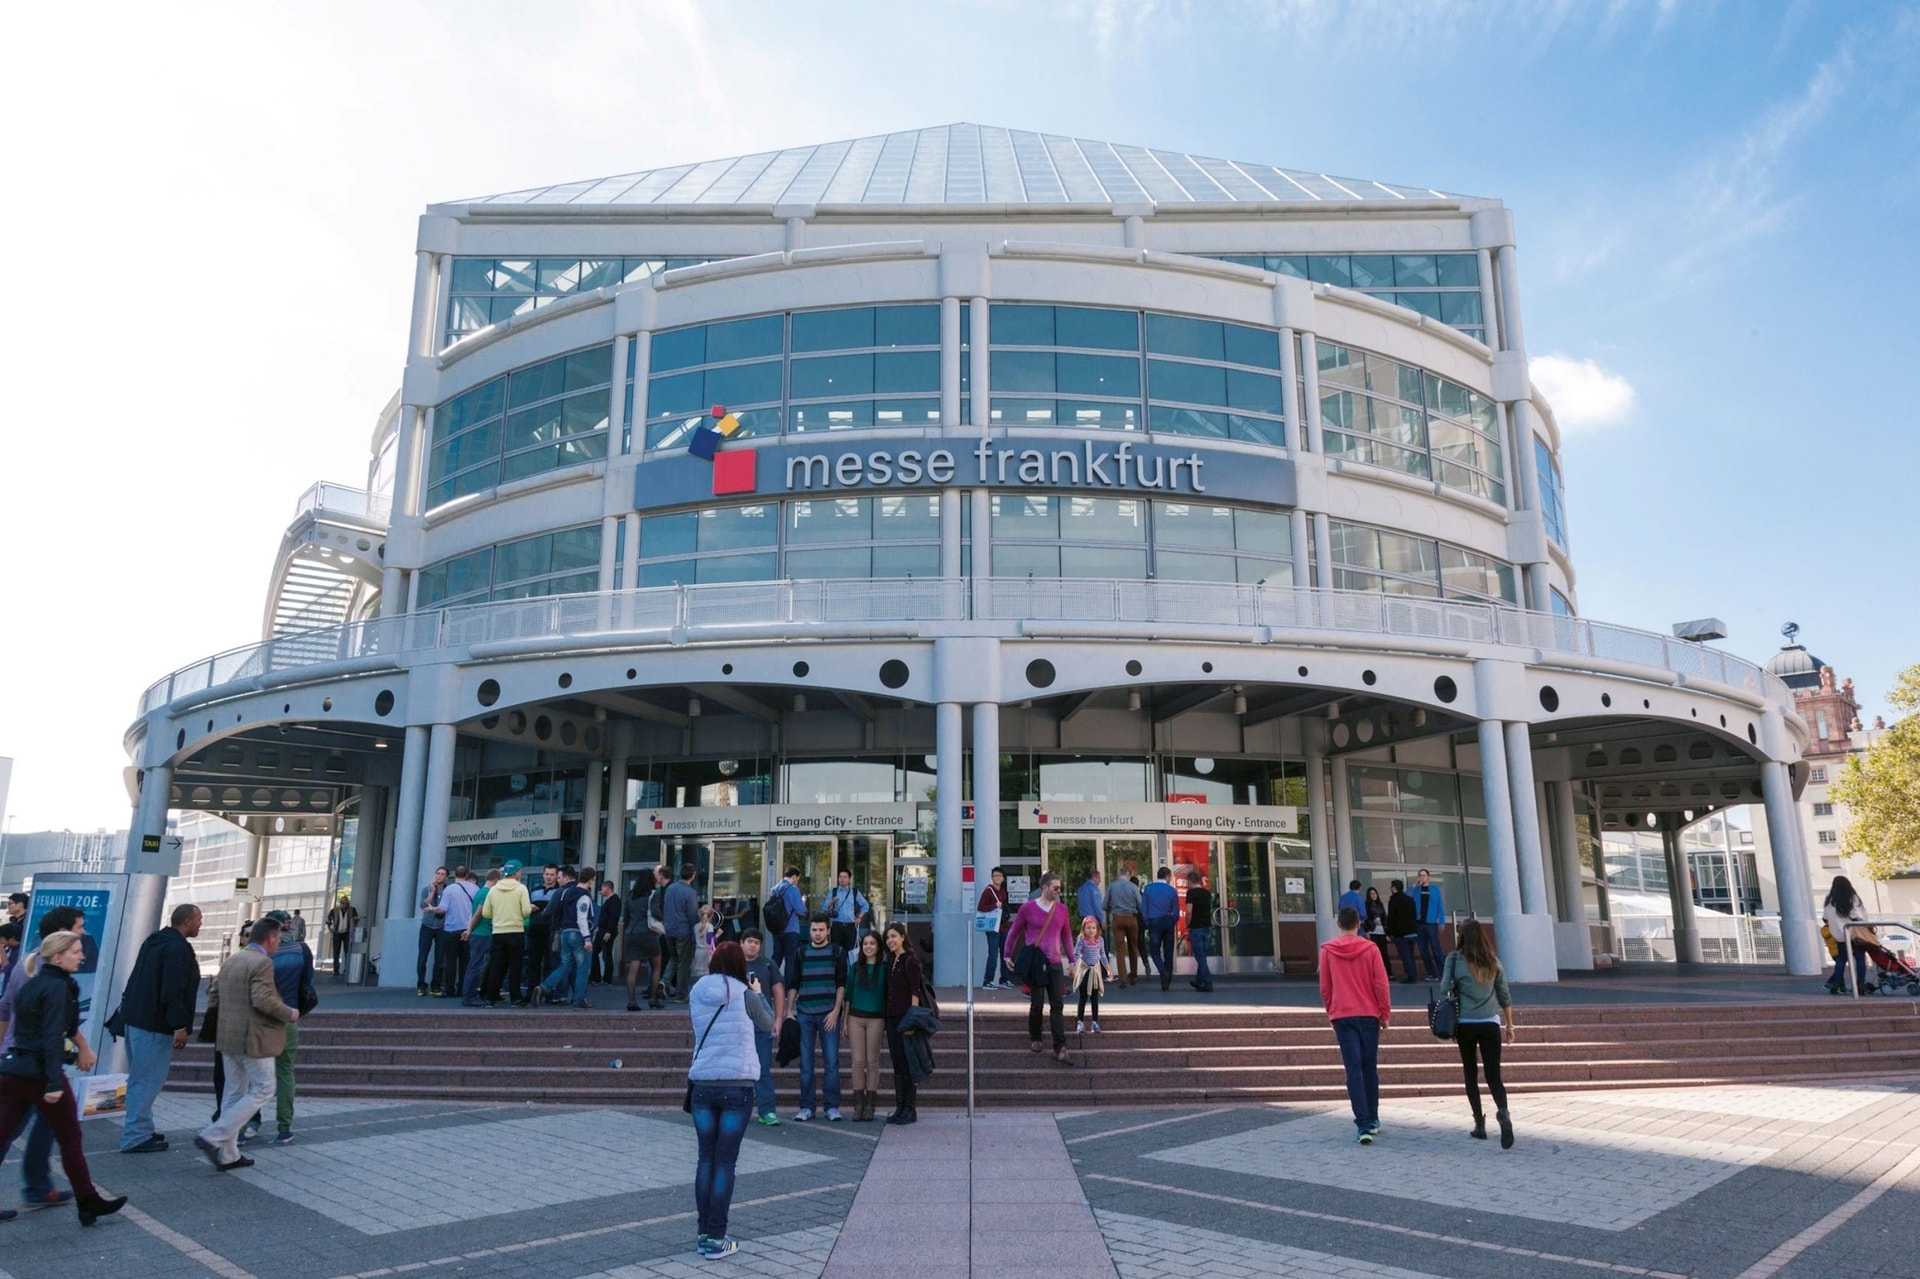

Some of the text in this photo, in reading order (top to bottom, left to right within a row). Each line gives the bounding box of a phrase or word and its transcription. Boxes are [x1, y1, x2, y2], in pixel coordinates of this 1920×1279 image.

[786, 439, 1206, 494] messe frankfurt
[667, 818, 741, 830] messe frankfurt
[776, 814, 904, 829] Eingang City Entrance
[1053, 813, 1134, 825] messe frankfurt
[1170, 814, 1287, 829] Eingang City Entrance
[448, 829, 498, 844] tenvorverkauf
